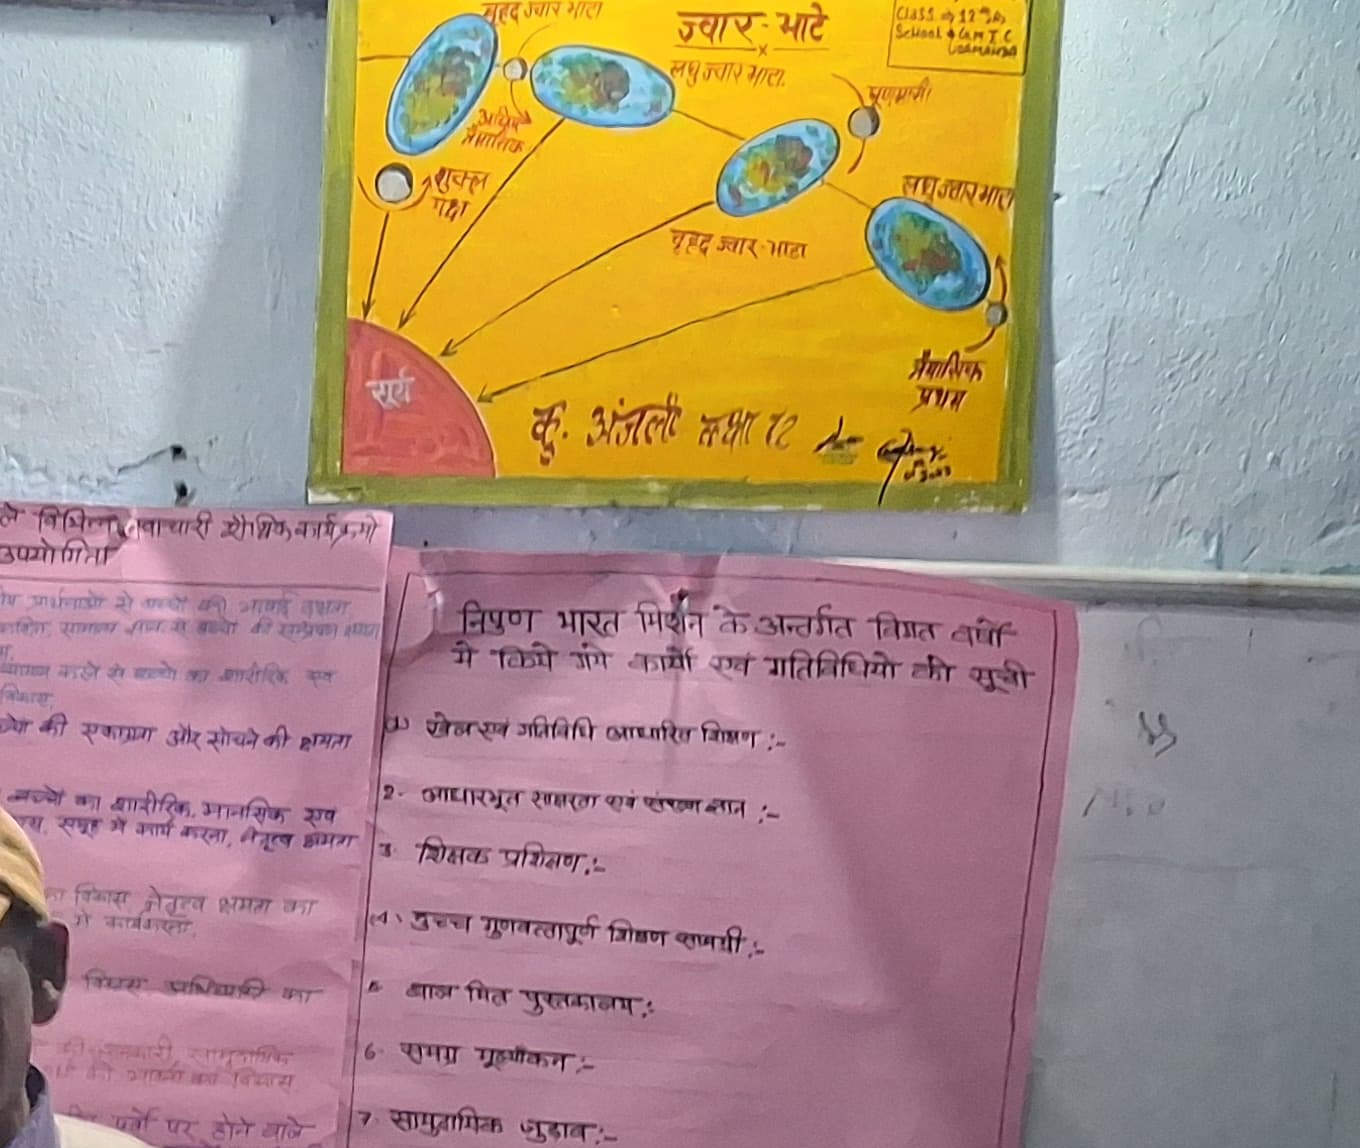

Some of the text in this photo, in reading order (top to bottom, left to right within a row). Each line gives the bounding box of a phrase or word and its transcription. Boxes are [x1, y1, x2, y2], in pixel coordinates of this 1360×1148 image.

[556, 609, 626, 638] भारत
[712, 604, 751, 635] के
[912, 654, 957, 684] की
[166, 1118, 200, 1144] पर
